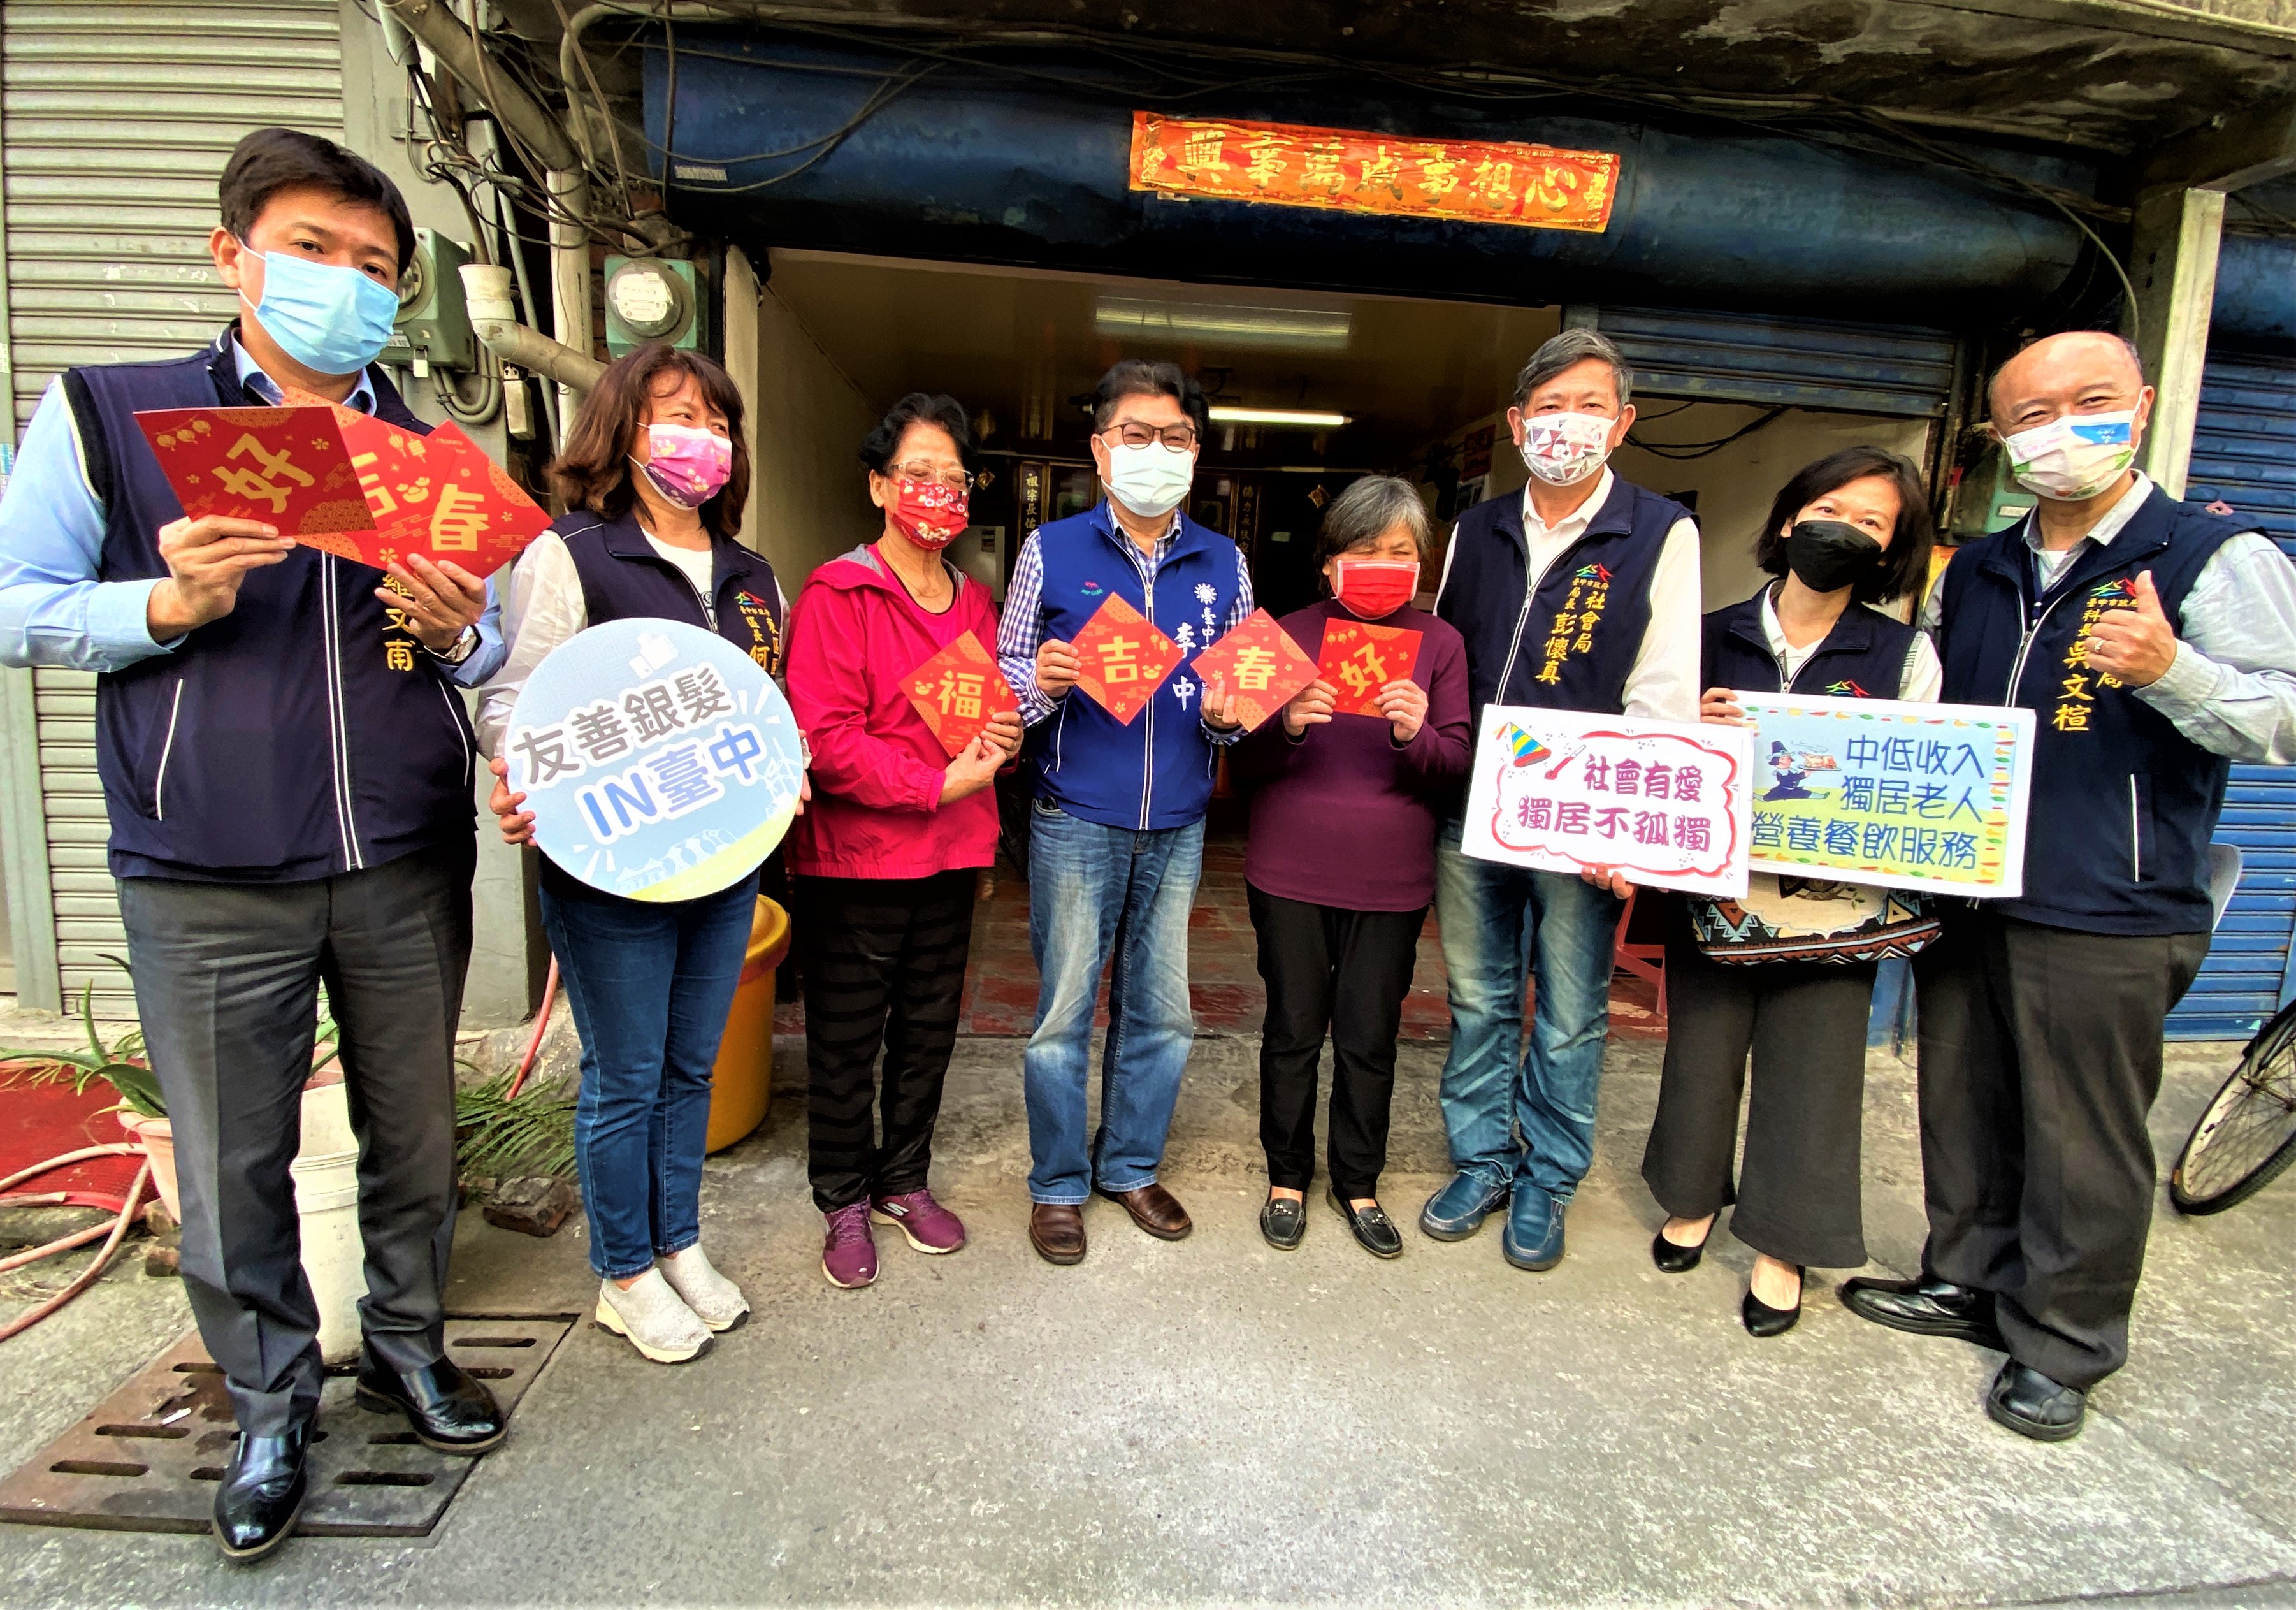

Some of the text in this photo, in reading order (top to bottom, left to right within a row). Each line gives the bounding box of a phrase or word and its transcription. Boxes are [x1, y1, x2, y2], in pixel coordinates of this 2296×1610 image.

[211, 433, 315, 514] 好
[428, 483, 490, 552] 春
[1571, 591, 1606, 653] 社會局
[1097, 635, 1141, 683] 吉
[1232, 646, 1277, 690] 春
[1339, 642, 1388, 698] 好
[937, 669, 985, 719] 福
[512, 667, 732, 785] 友善銀髮
[582, 727, 762, 838] IN臺中
[1584, 754, 1703, 803] 社會有愛
[1846, 734, 1984, 778] 中低收入
[1517, 795, 1711, 852] 獨居不孤獨
[1840, 775, 1983, 823] 獨居老人
[1751, 810, 1979, 870] 營養餐飲服務
